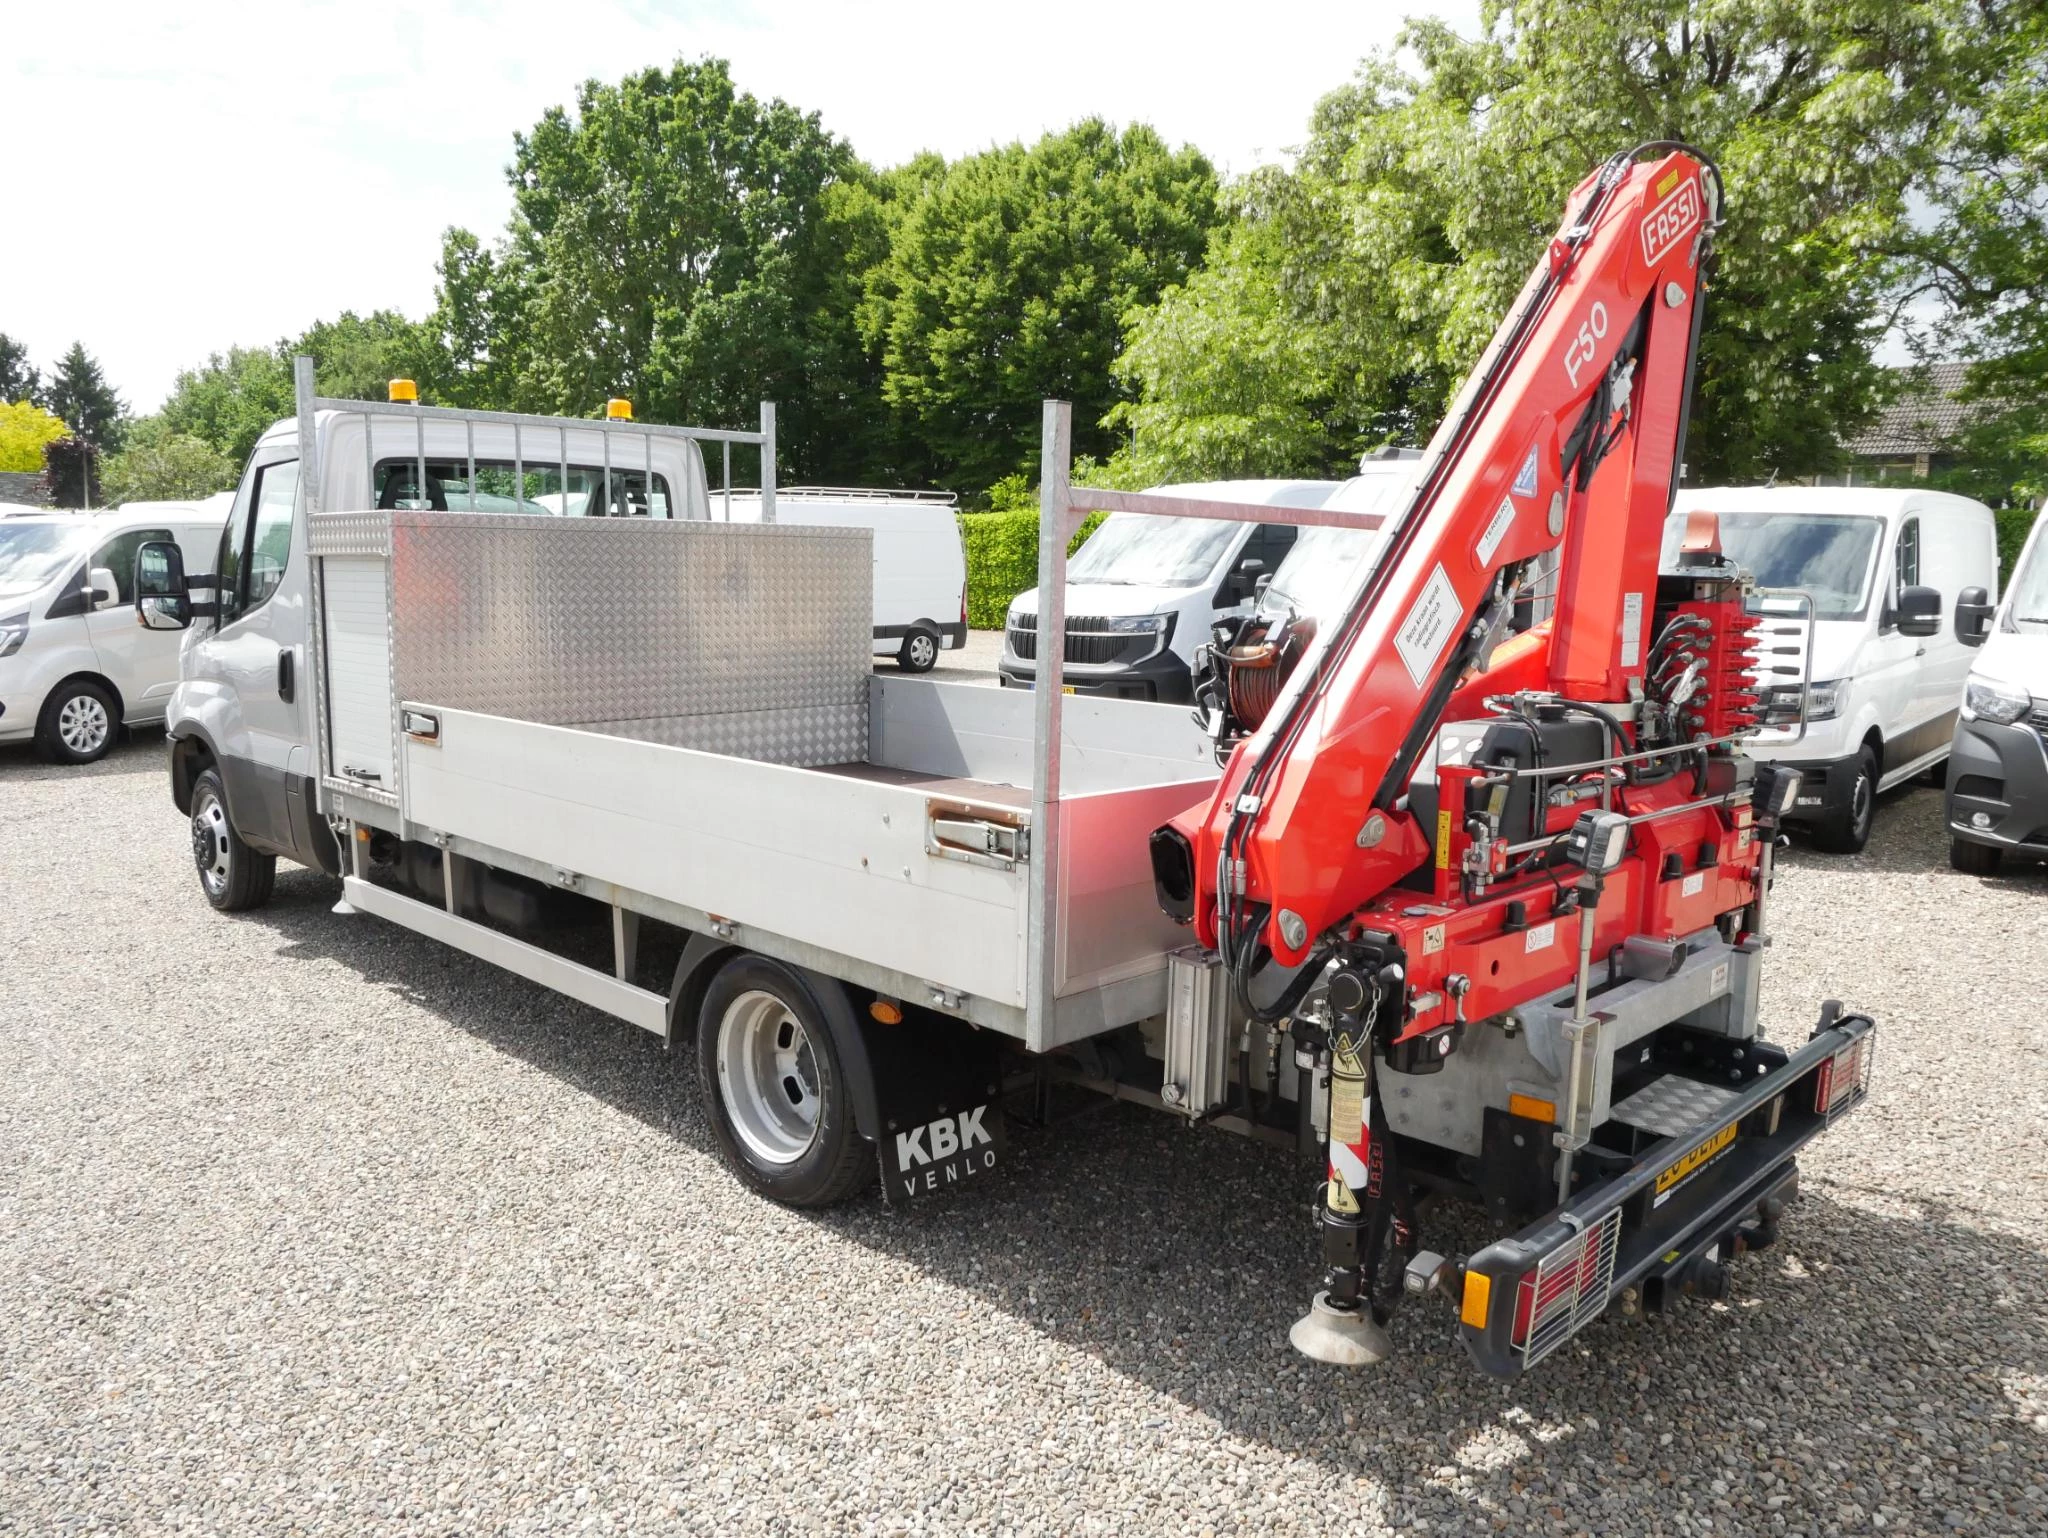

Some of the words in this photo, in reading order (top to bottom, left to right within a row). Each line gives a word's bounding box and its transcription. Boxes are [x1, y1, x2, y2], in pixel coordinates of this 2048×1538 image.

[1646, 188, 1695, 255] FASSI
[1564, 301, 1608, 389] F50
[1405, 624, 1418, 644] Deze
[1416, 605, 1429, 626] kraan
[1428, 584, 1441, 606] wordt
[1414, 601, 1441, 648] radiografisch
[896, 1105, 992, 1172] KBK
[904, 1150, 996, 1196] VENLO
